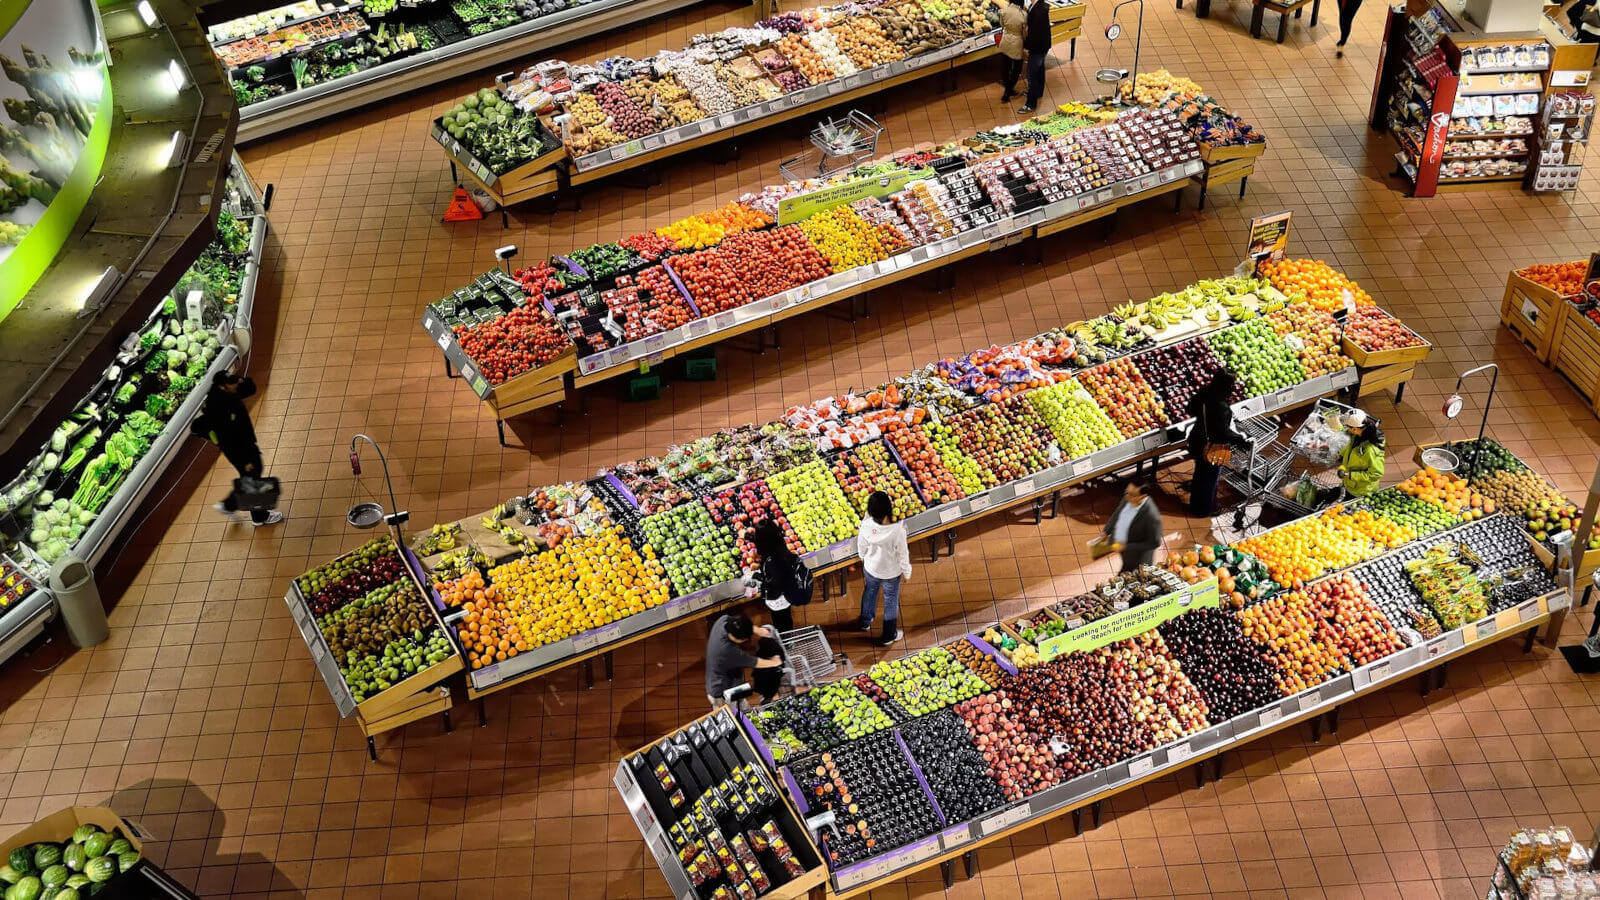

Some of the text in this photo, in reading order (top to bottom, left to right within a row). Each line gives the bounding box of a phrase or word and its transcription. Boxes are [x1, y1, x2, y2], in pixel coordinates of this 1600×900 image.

[802, 194, 822, 202] Looking
[1072, 627, 1099, 641] Looking
[1111, 611, 1144, 626] nutritious
[1146, 598, 1174, 613] choices?
[1091, 629, 1111, 640] Reach
[1124, 620, 1135, 629] the
[1137, 611, 1157, 624] Stars!
